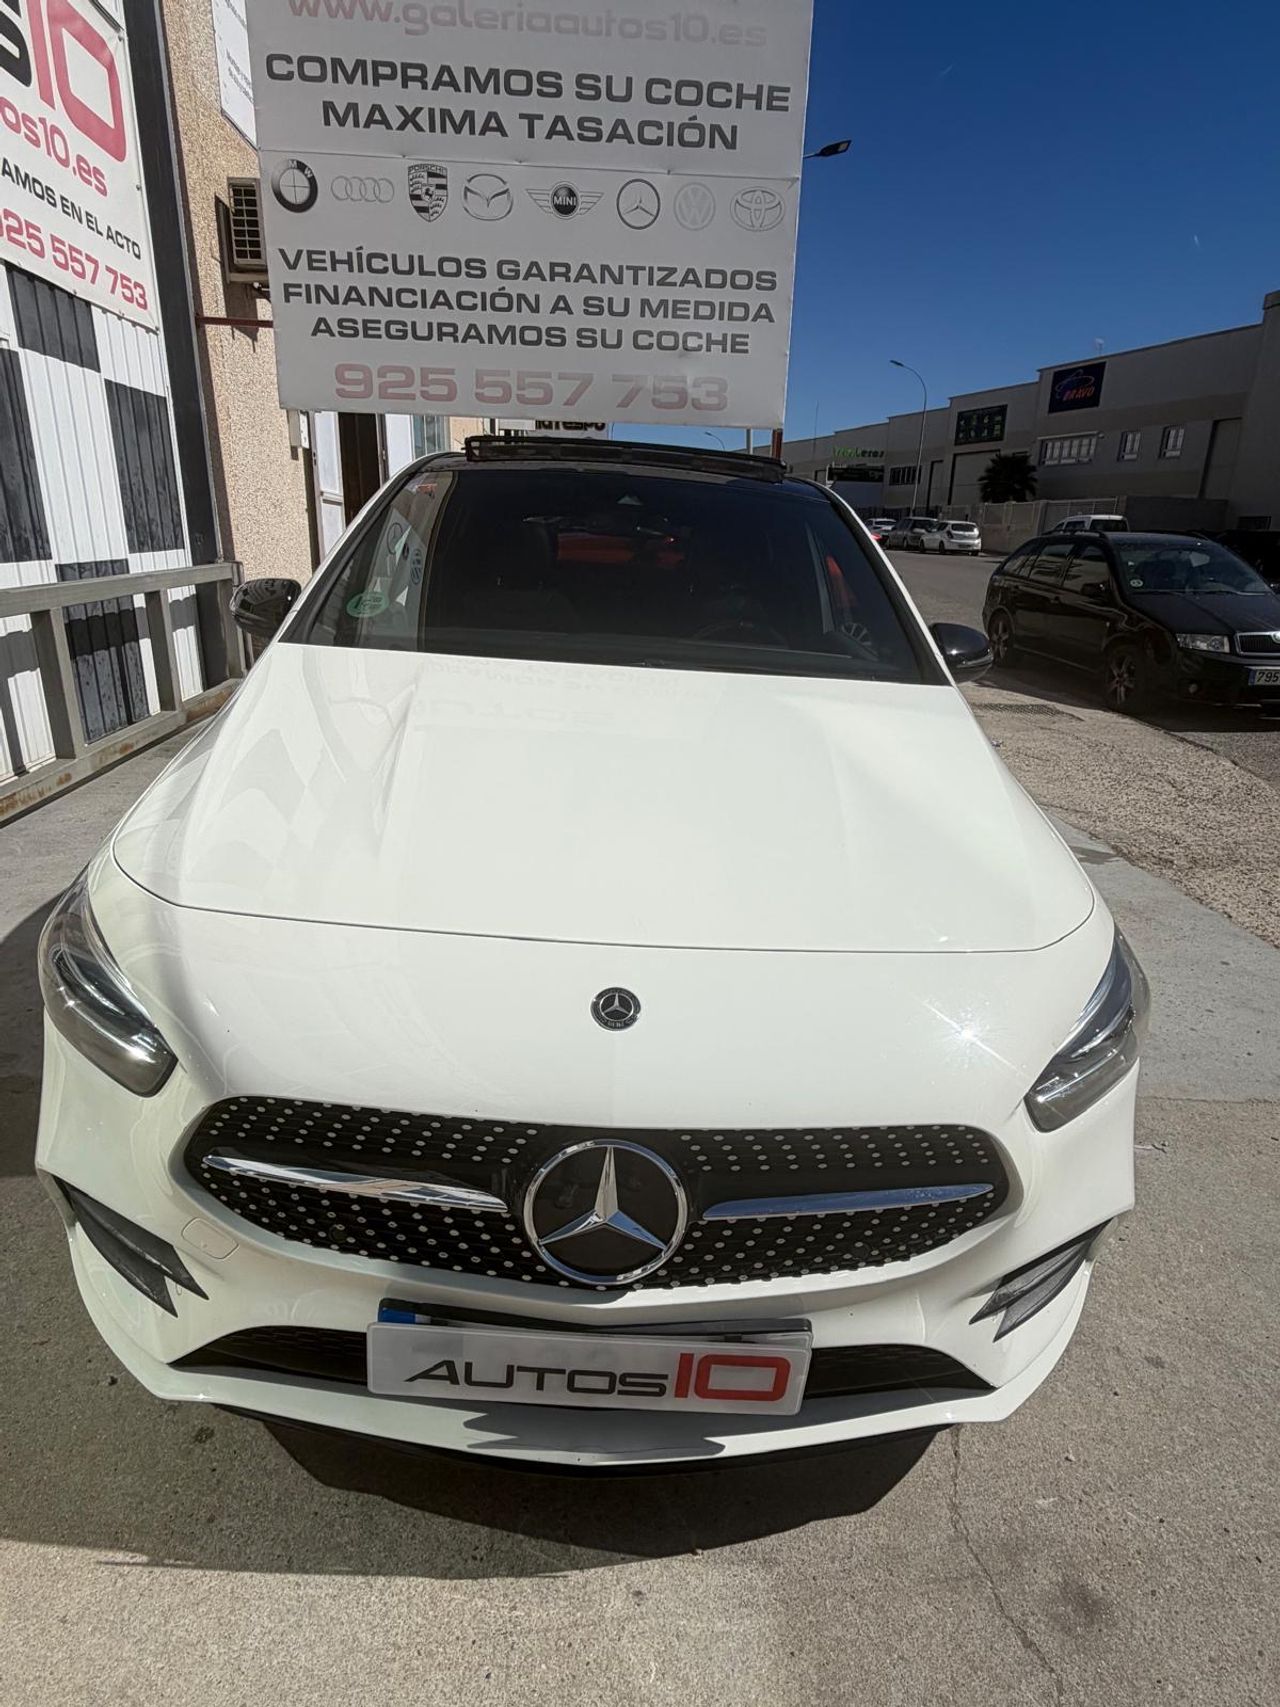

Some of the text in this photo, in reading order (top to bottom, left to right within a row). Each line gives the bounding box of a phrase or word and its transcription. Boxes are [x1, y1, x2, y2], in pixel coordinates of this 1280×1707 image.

[288, 0, 767, 48] www.galeriaautos10.es
[266, 53, 563, 99] COMPRAMOS
[575, 73, 633, 103] SU
[645, 77, 791, 112] COCHE
[322, 101, 738, 150] MAXIMA TASACIÓN
[2, 157, 142, 260] AMOS EN EL ACTO
[553, 196, 577, 206] MINI
[0, 208, 148, 310] 25 557 753
[279, 246, 777, 291] VEHÍCULOS GARANTIZADOS
[283, 284, 775, 323] FINANCIACIÓN A SU MEDIDA
[310, 317, 749, 354] ASEGURAMOS SU COCHE
[334, 363, 729, 411] 925 557 753
